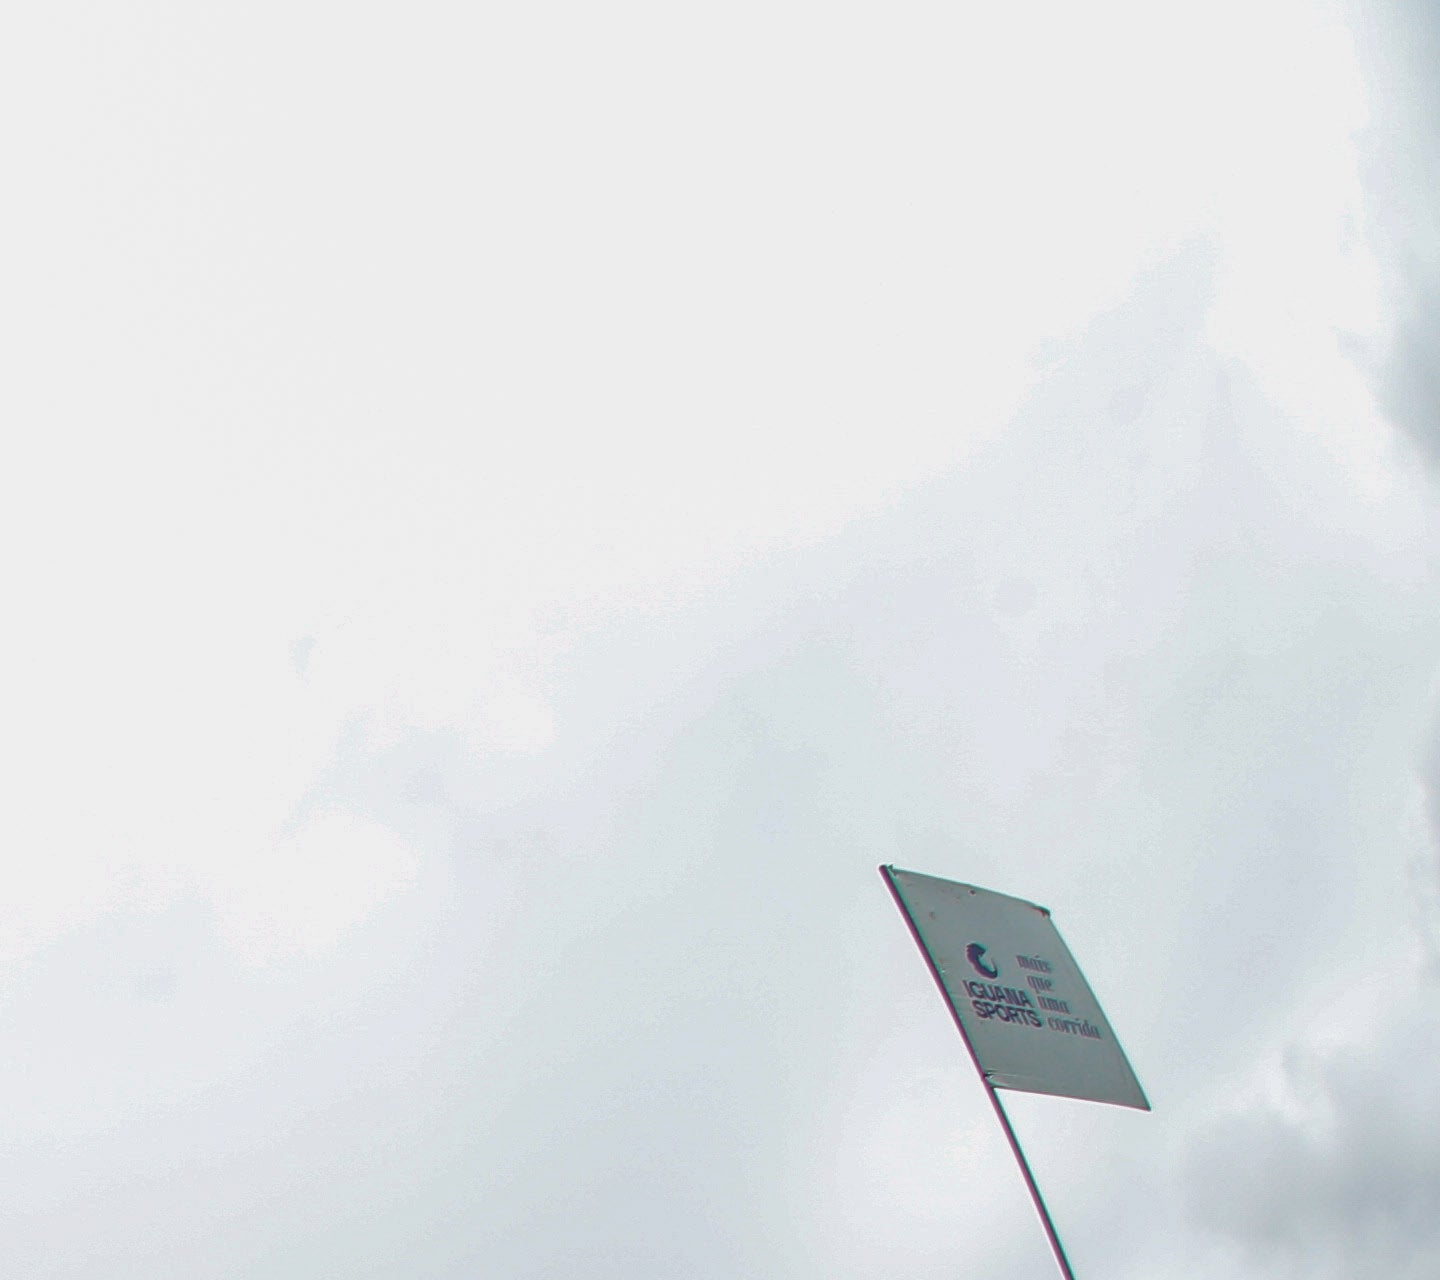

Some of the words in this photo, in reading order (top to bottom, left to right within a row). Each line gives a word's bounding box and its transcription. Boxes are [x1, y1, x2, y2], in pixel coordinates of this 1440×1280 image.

[963, 979, 1032, 1009] IGUANA
[1026, 974, 1055, 994] que
[972, 1000, 1042, 1028] SPORTS
[1047, 1017, 1102, 1039] corrida
